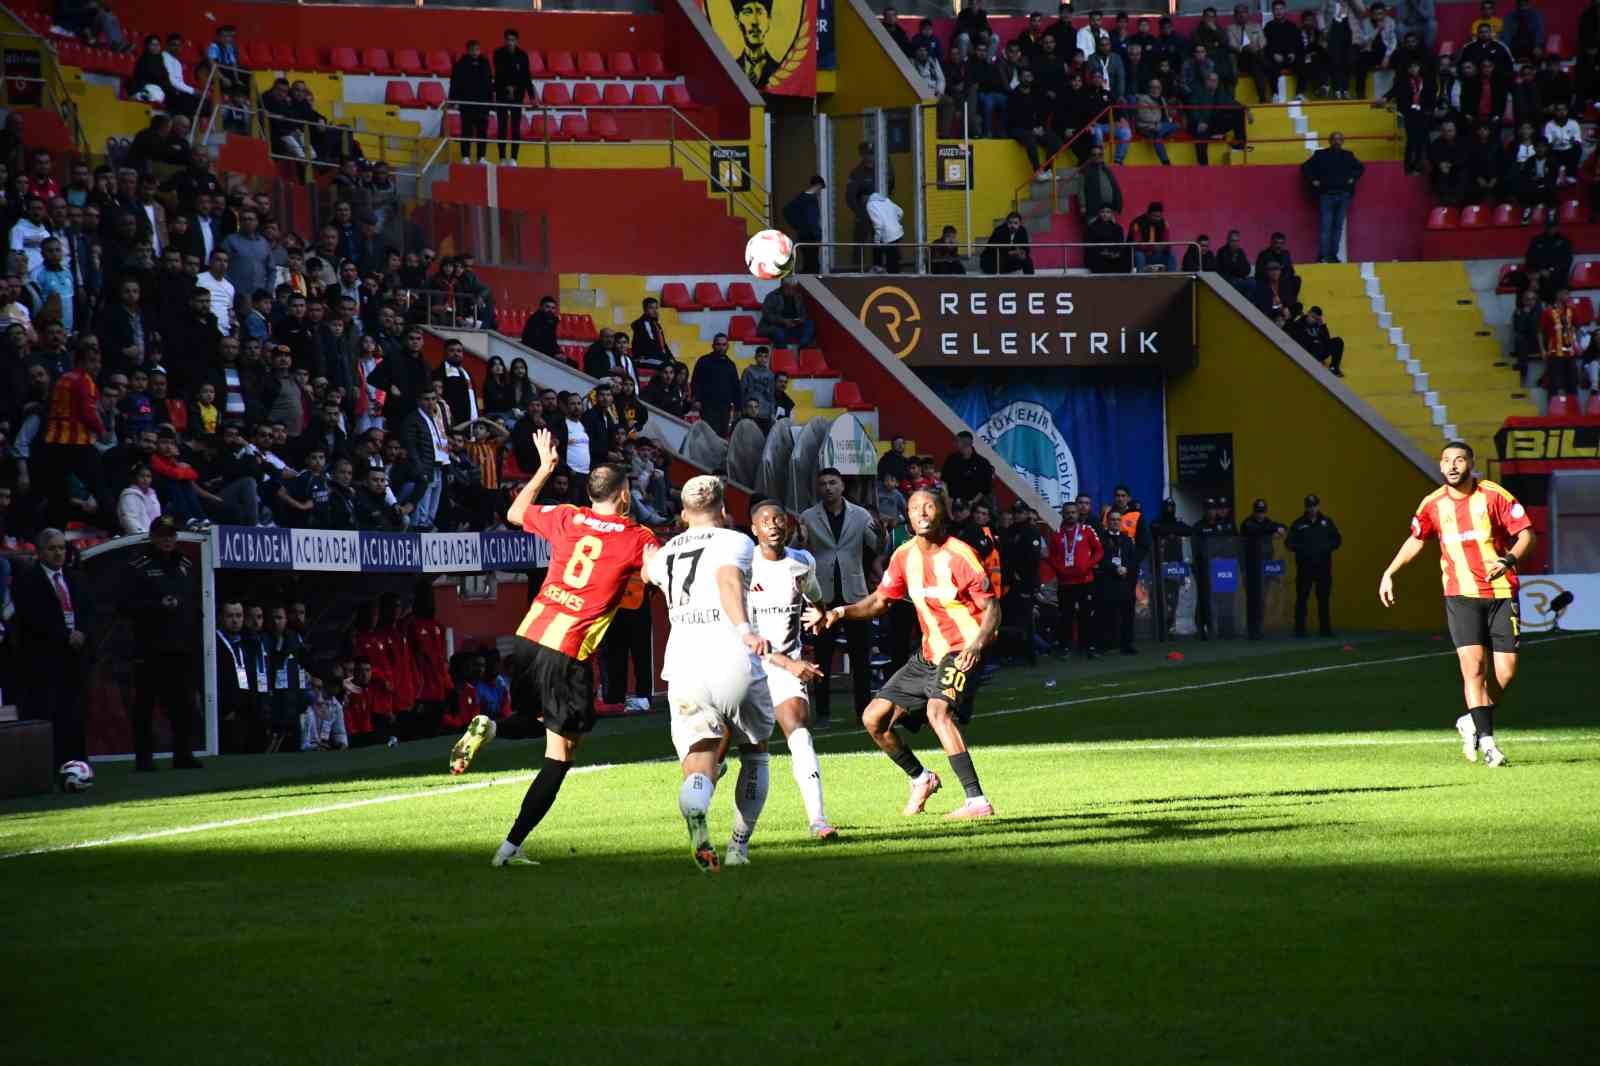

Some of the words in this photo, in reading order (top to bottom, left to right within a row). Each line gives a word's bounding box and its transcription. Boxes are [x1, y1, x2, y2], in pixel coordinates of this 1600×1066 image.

[940, 293, 1074, 315] REGES
[941, 327, 1159, 355] ELEKTRİK
[225, 533, 291, 562] ACIBADEM
[295, 535, 358, 565] ACIBADEM
[363, 537, 421, 567] ACIBADEM
[424, 539, 479, 567] ACIBADEM
[483, 537, 537, 563] ACIBADEM
[562, 535, 603, 589] 8
[666, 547, 705, 610] 17
[941, 667, 966, 692] 30
